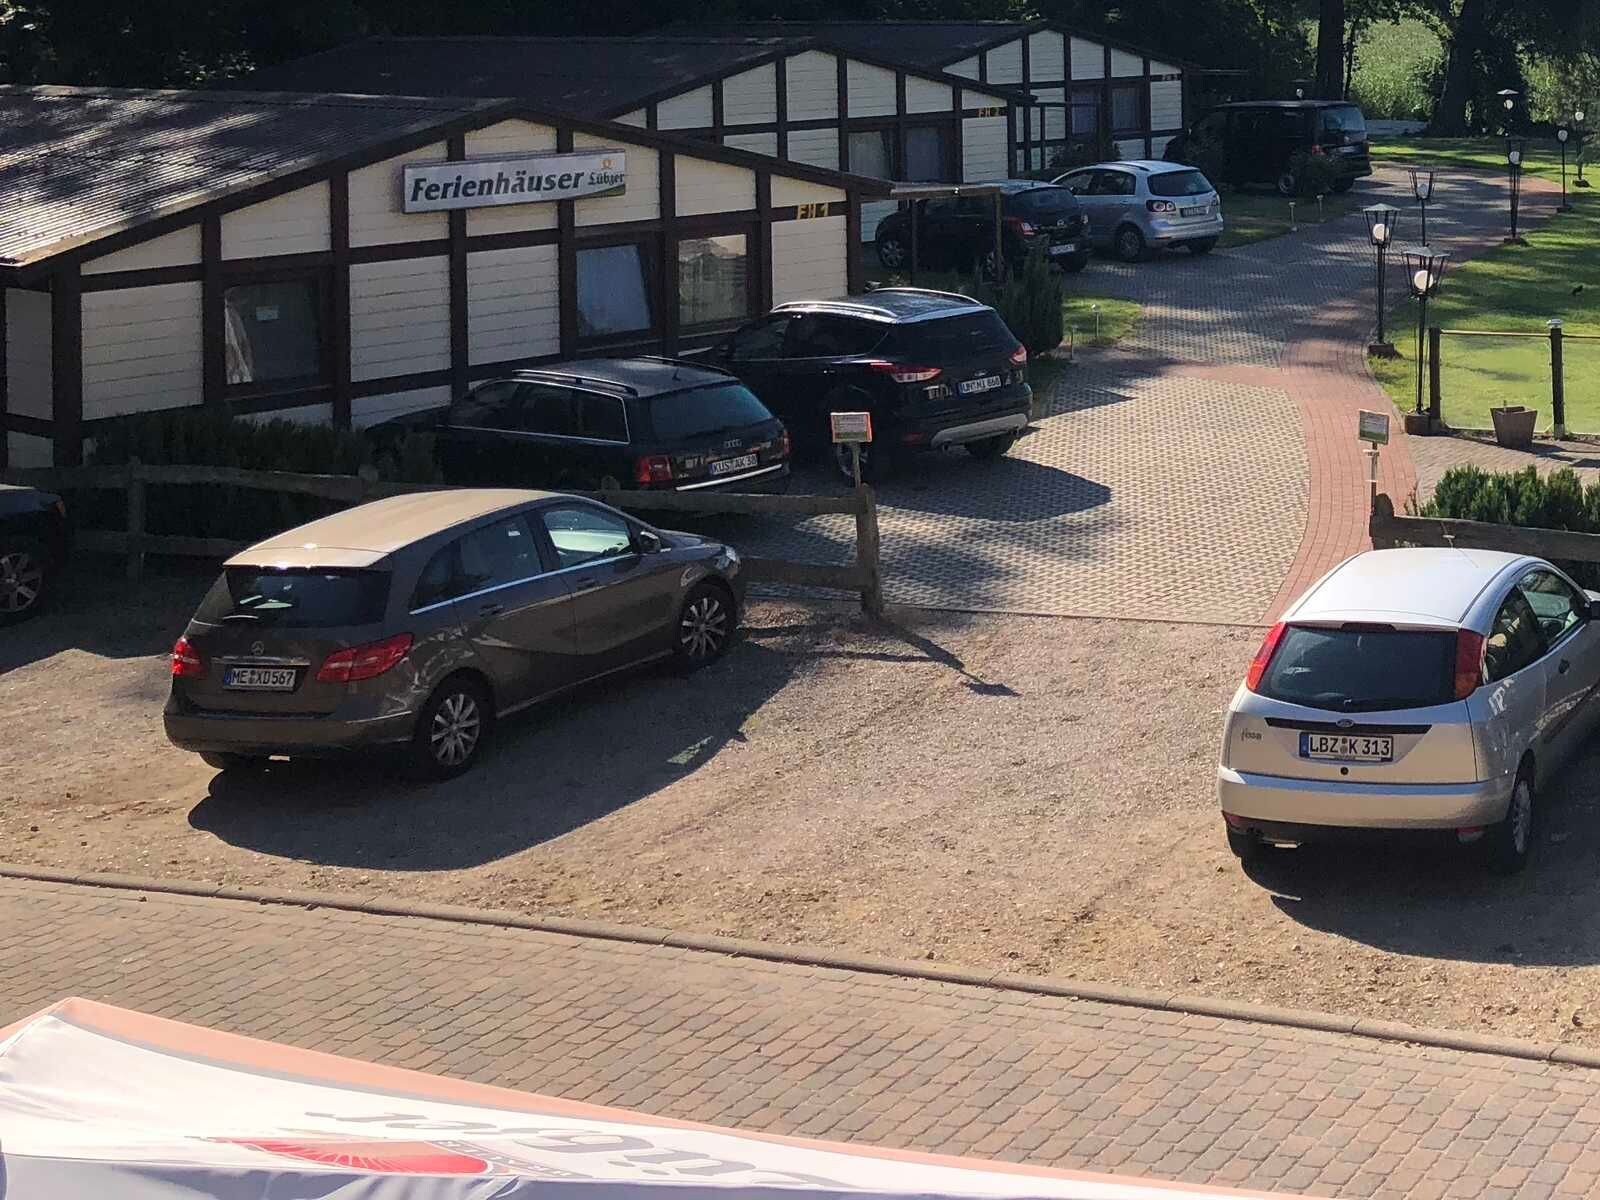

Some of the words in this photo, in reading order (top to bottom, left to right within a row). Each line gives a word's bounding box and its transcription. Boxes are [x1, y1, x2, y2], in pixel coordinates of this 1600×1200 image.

[410, 170, 584, 202] Ferienhäuser
[796, 203, 816, 222] FH
[231, 670, 249, 684] ME
[1309, 736, 1339, 754] LBZ
[1348, 738, 1358, 755] K
[1362, 739, 1390, 756] 313
